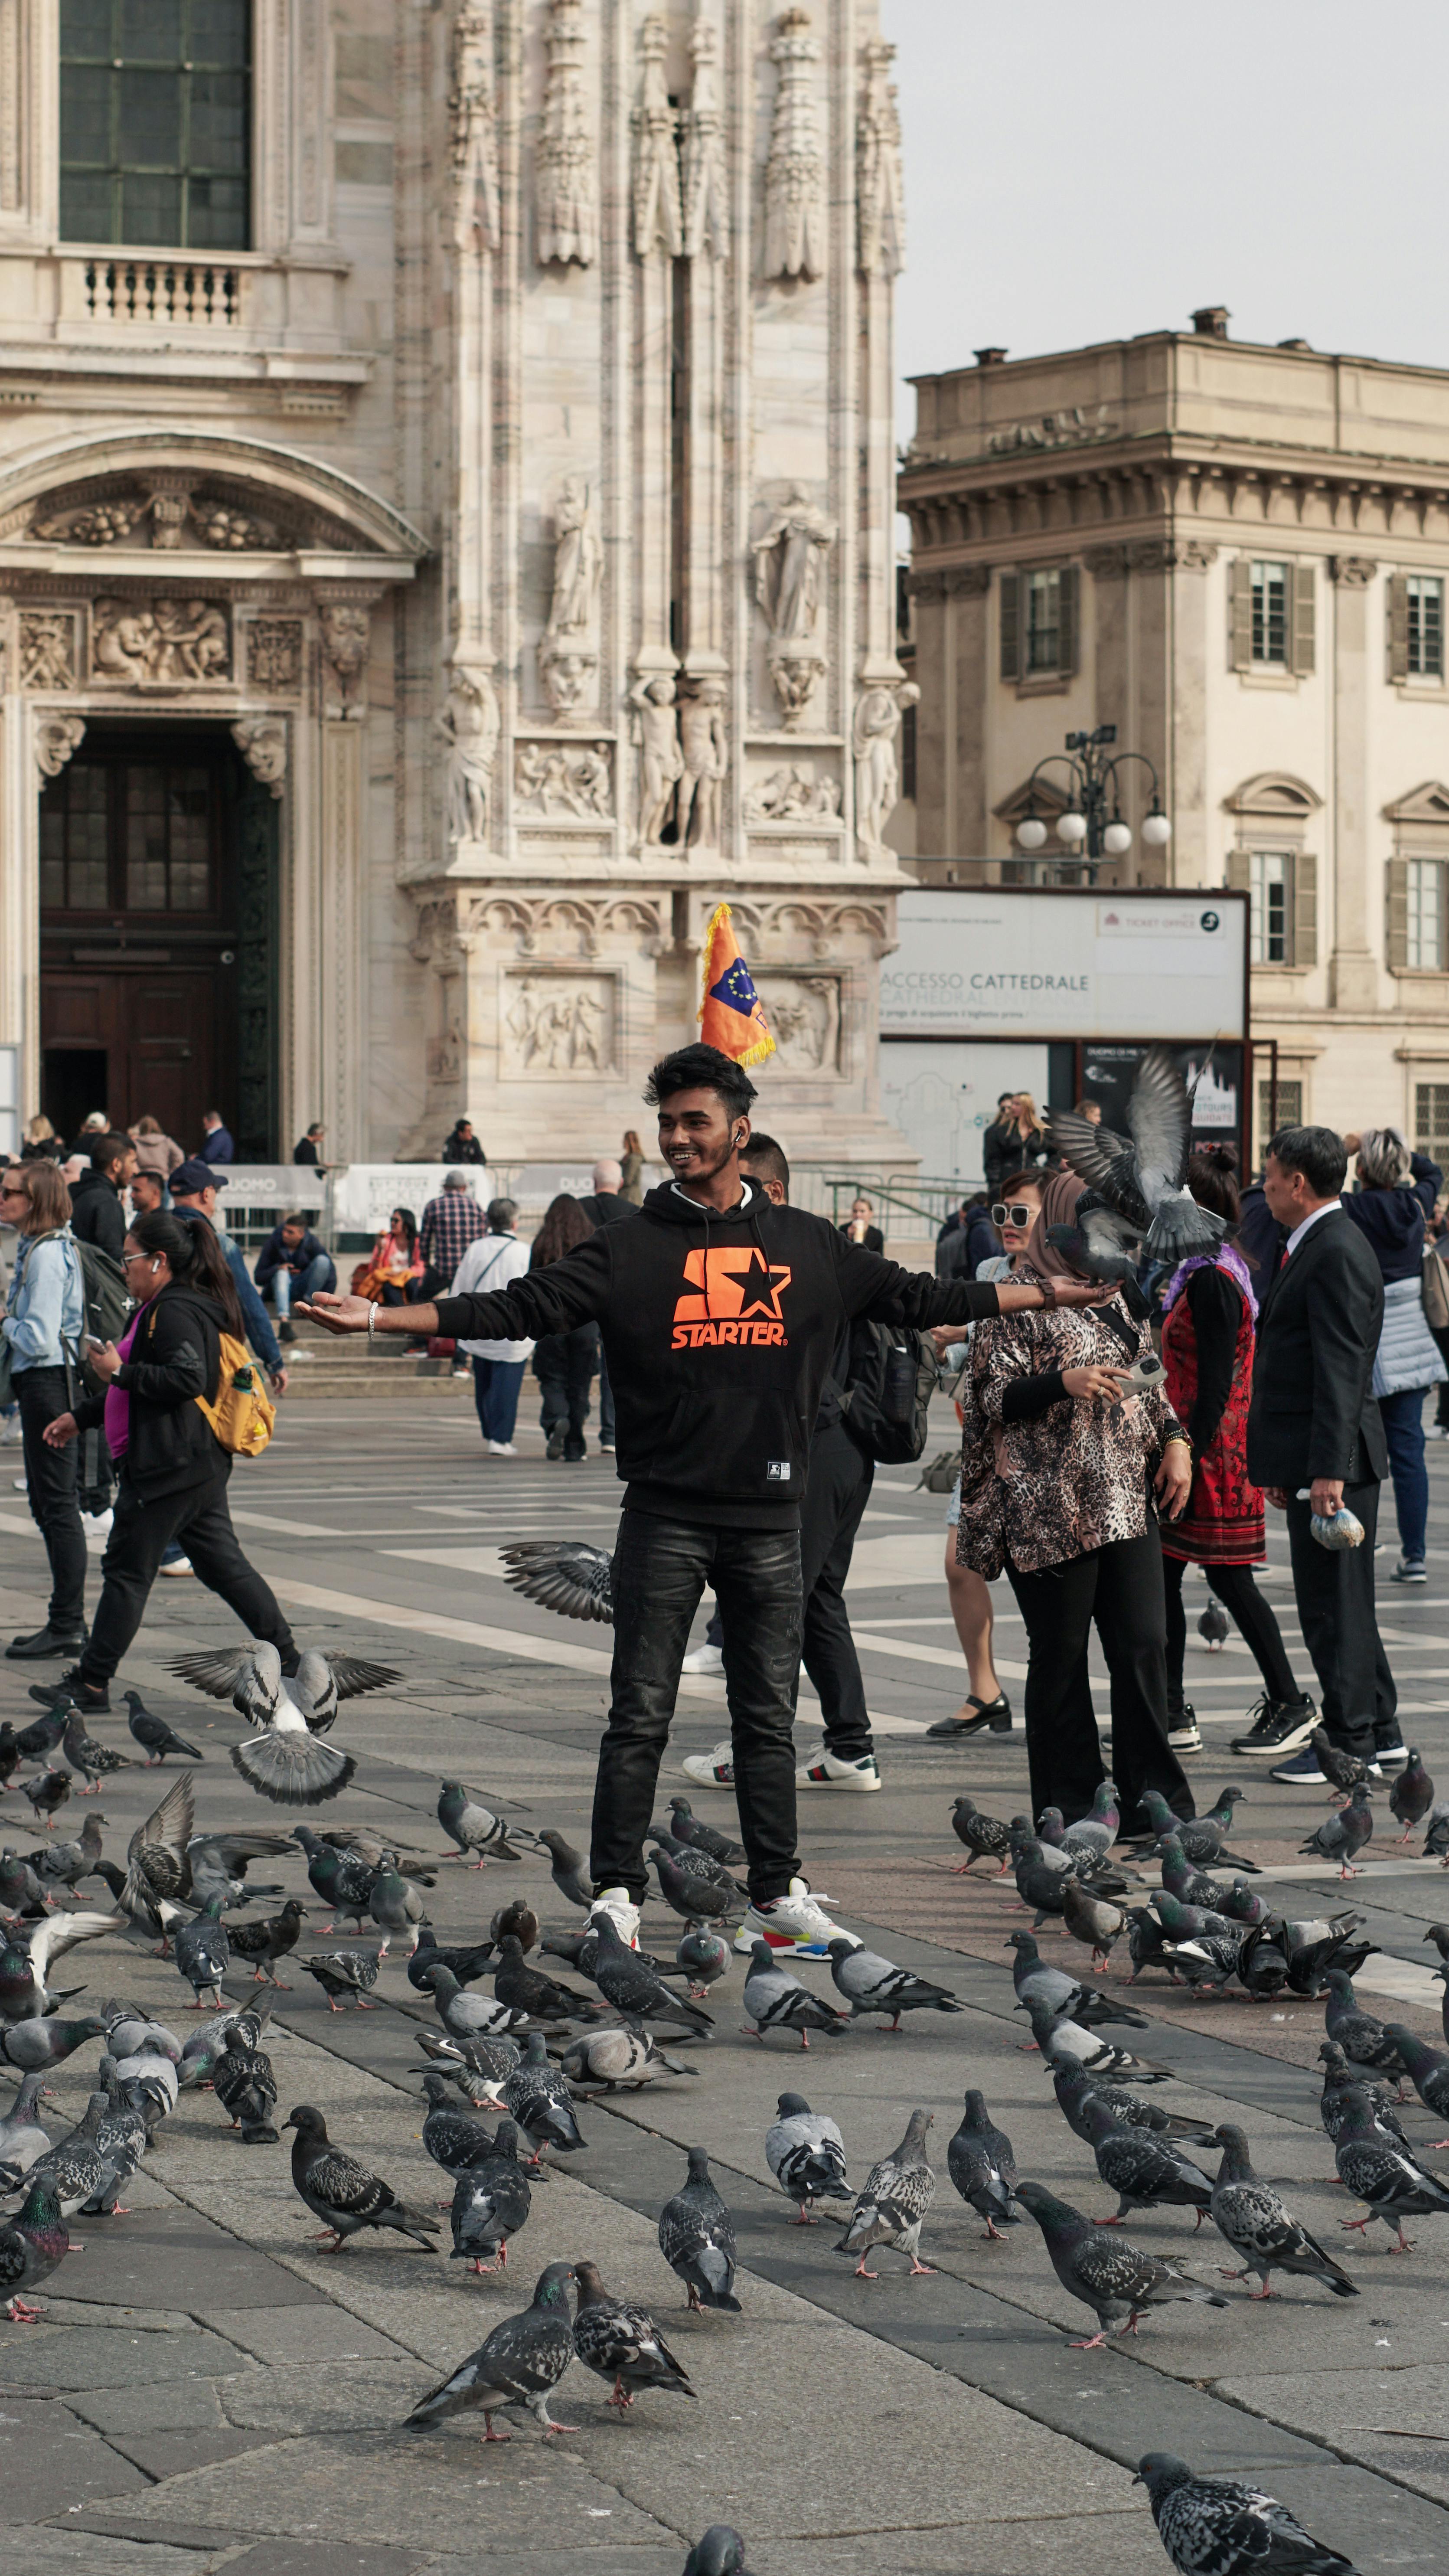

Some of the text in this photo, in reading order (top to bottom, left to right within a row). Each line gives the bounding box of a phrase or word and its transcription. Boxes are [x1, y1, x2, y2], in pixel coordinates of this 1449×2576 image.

[881, 972, 1089, 991] ACCESSO CATTEDRALE
[880, 989, 987, 1005] CATHEDRAL
[671, 1321, 785, 1349] STARTER
